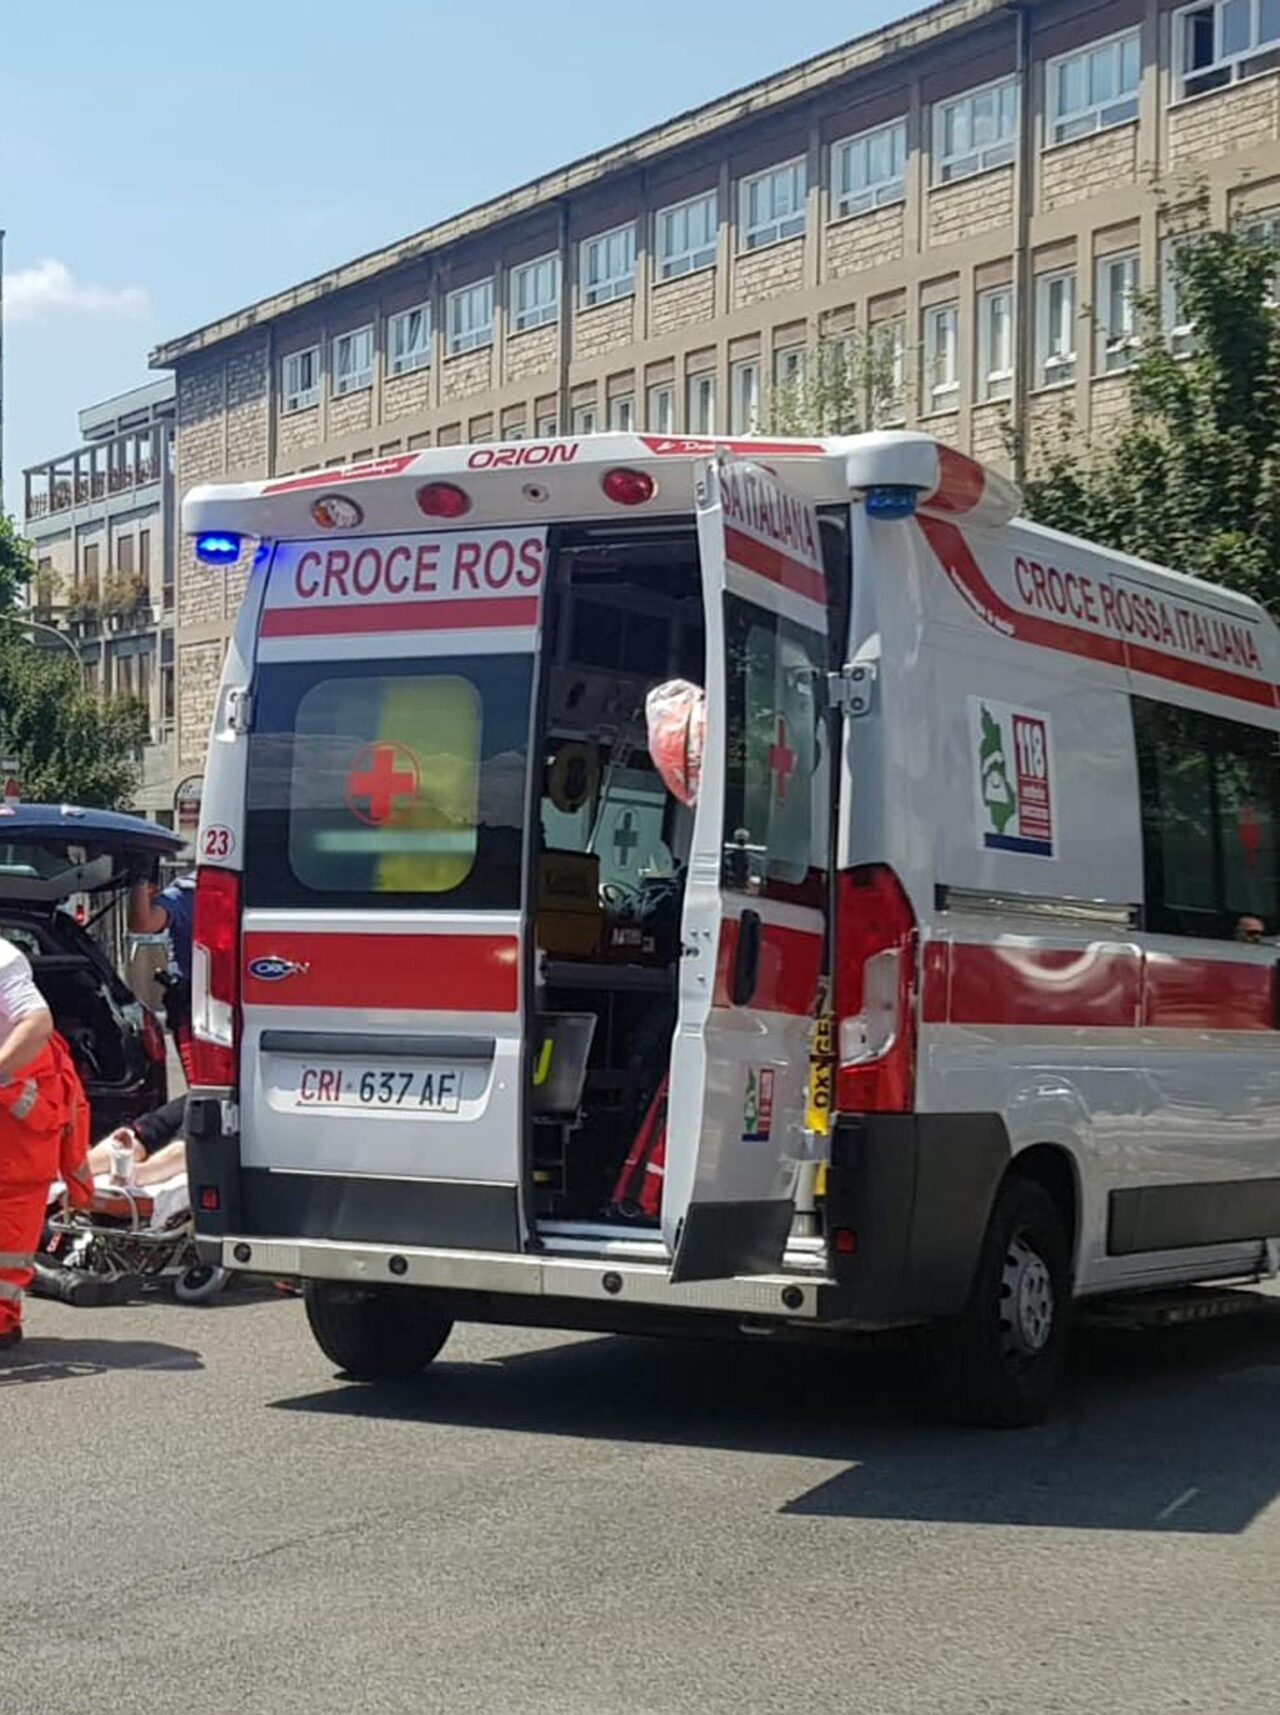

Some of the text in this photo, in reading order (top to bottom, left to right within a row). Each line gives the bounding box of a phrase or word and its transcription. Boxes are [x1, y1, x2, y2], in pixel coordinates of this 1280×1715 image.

[468, 443, 580, 469] ORION
[744, 471, 817, 561] ITALIANA
[295, 538, 544, 598] CROCE ROS
[1015, 556, 1098, 624] CROCE
[1099, 583, 1176, 647] ROSSA
[1175, 608, 1262, 671] ITALIANA
[1016, 720, 1046, 780] 118
[206, 829, 229, 856] 23
[301, 1069, 455, 1106] CRI 637 AF
